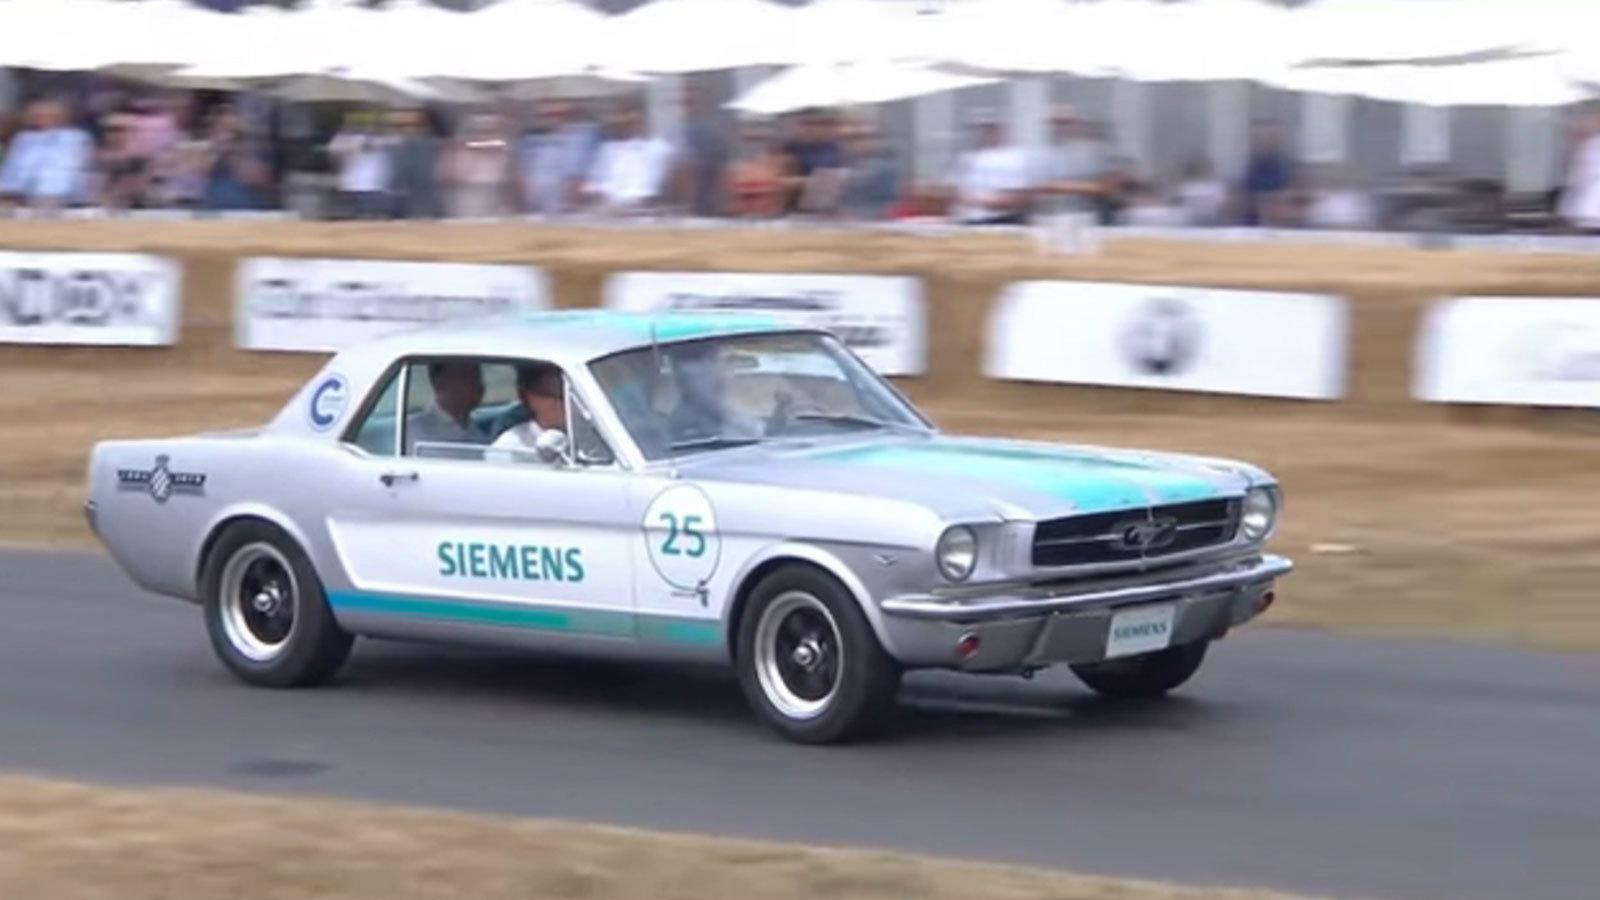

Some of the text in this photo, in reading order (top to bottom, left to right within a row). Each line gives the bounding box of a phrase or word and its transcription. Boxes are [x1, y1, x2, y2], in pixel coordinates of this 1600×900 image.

[311, 378, 341, 426] C
[659, 512, 706, 558] 25
[437, 541, 585, 583] SIEMENS
